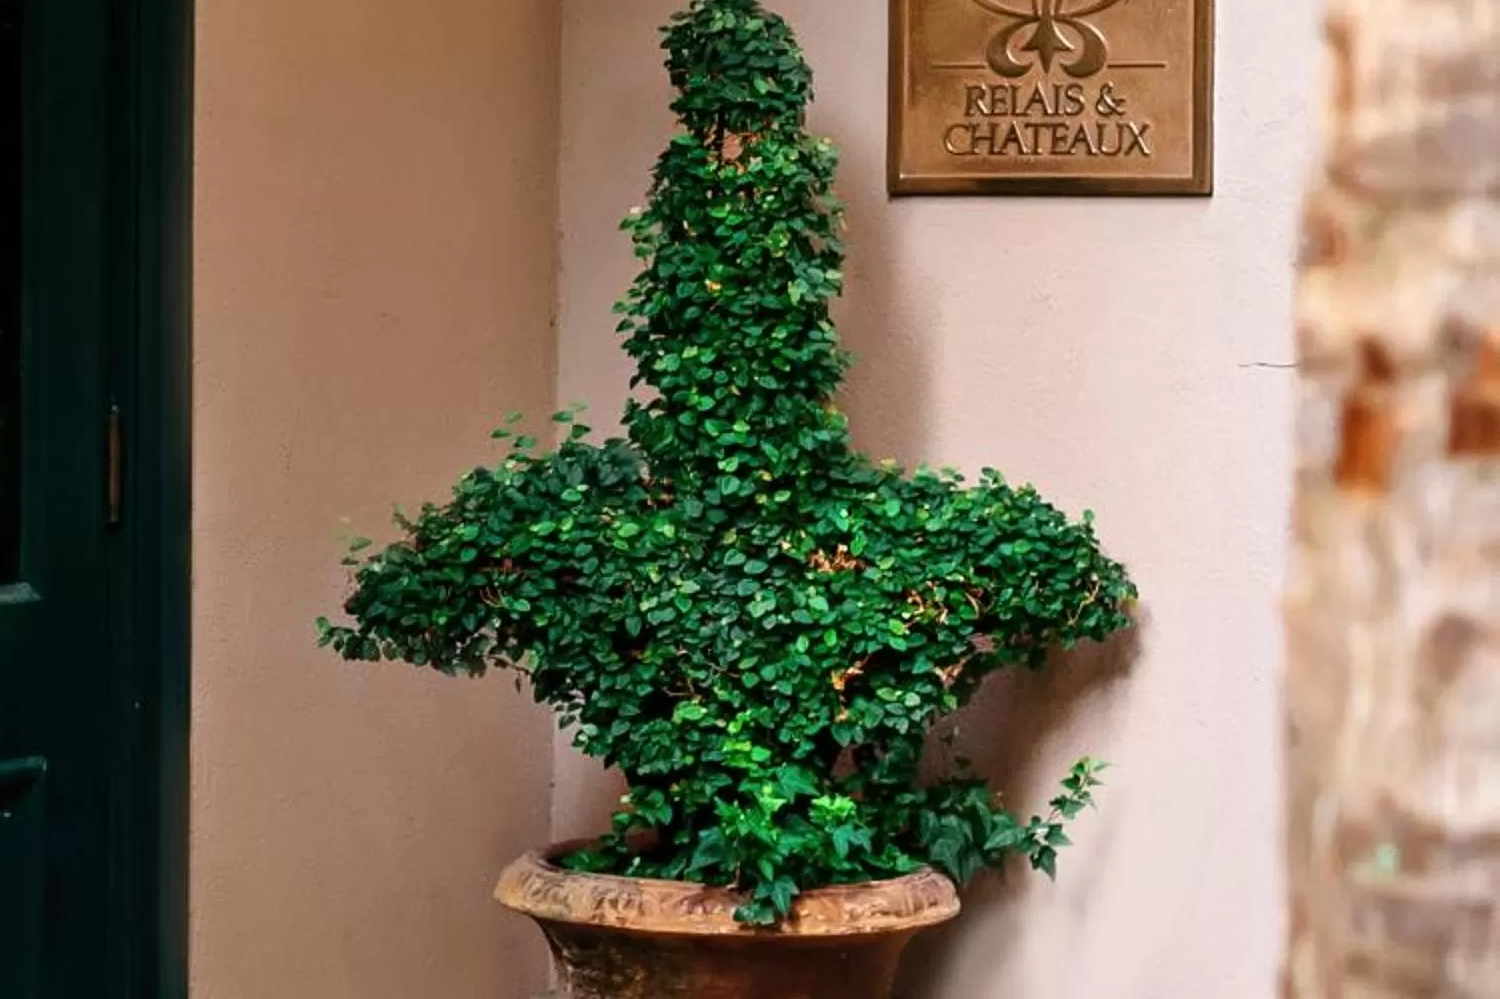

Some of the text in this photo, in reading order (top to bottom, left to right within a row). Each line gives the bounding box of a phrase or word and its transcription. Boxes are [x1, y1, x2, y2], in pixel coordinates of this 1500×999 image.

[963, 80, 1127, 118] RELAIS &
[943, 120, 1151, 156] CHATEAUX
